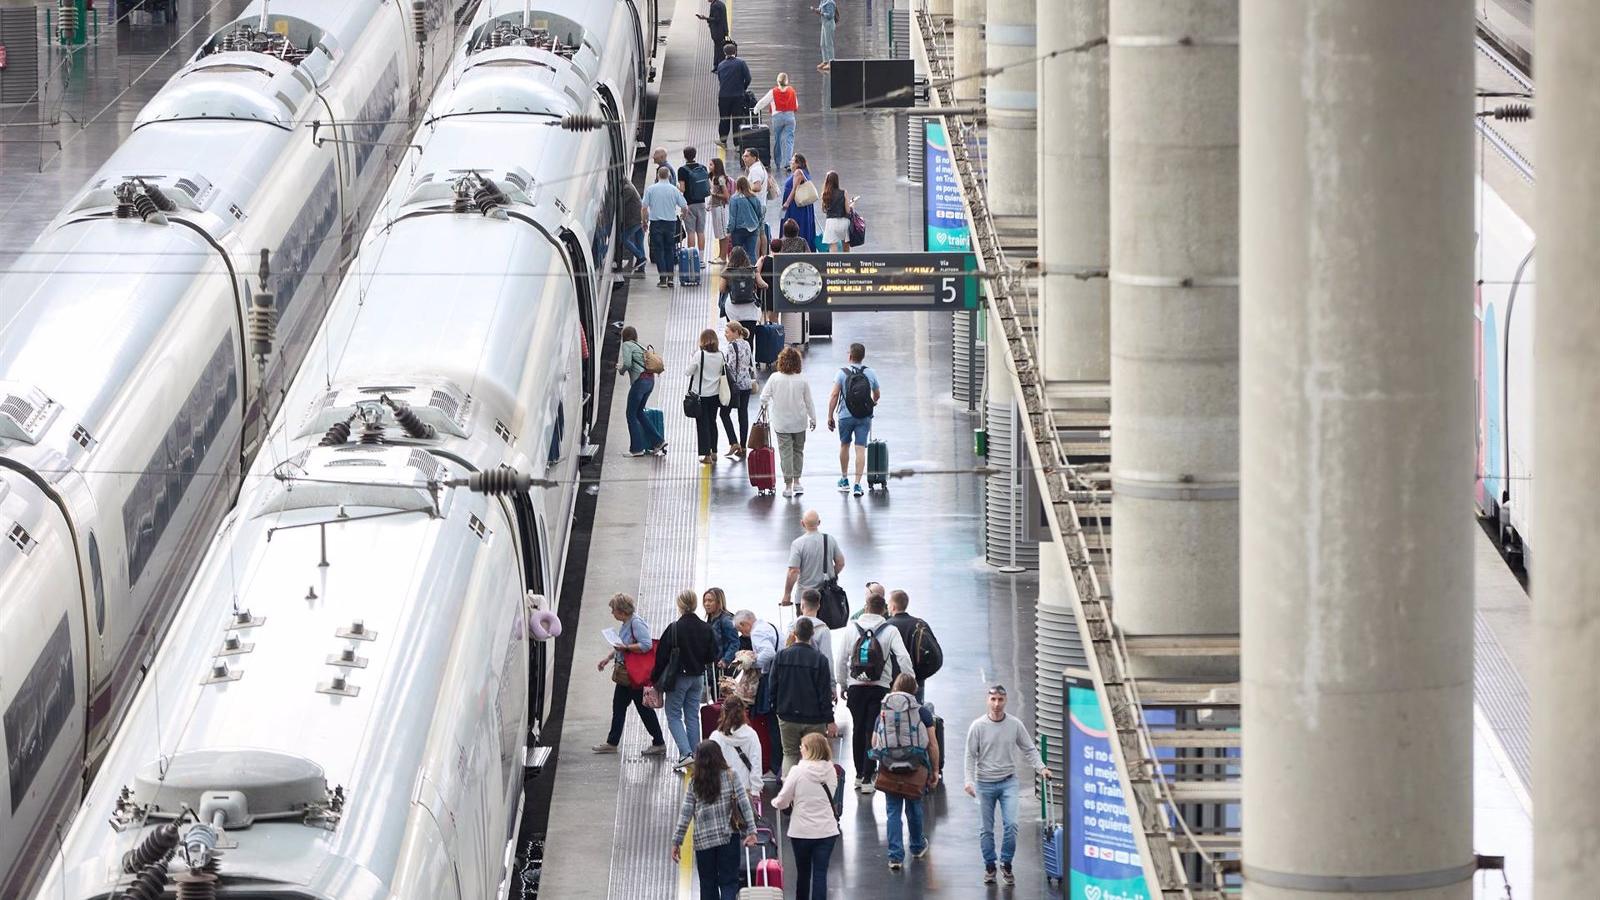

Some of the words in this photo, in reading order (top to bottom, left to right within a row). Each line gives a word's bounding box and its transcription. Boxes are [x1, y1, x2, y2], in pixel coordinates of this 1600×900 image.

[942, 277, 956, 303] 5
[1084, 745, 1094, 760] Si
[1095, 750, 1108, 762] no
[1084, 763, 1094, 776] el
[1094, 766, 1119, 782] mejo
[1084, 782, 1097, 794] en
[1084, 799, 1096, 810] es
[1084, 815, 1097, 828] no
